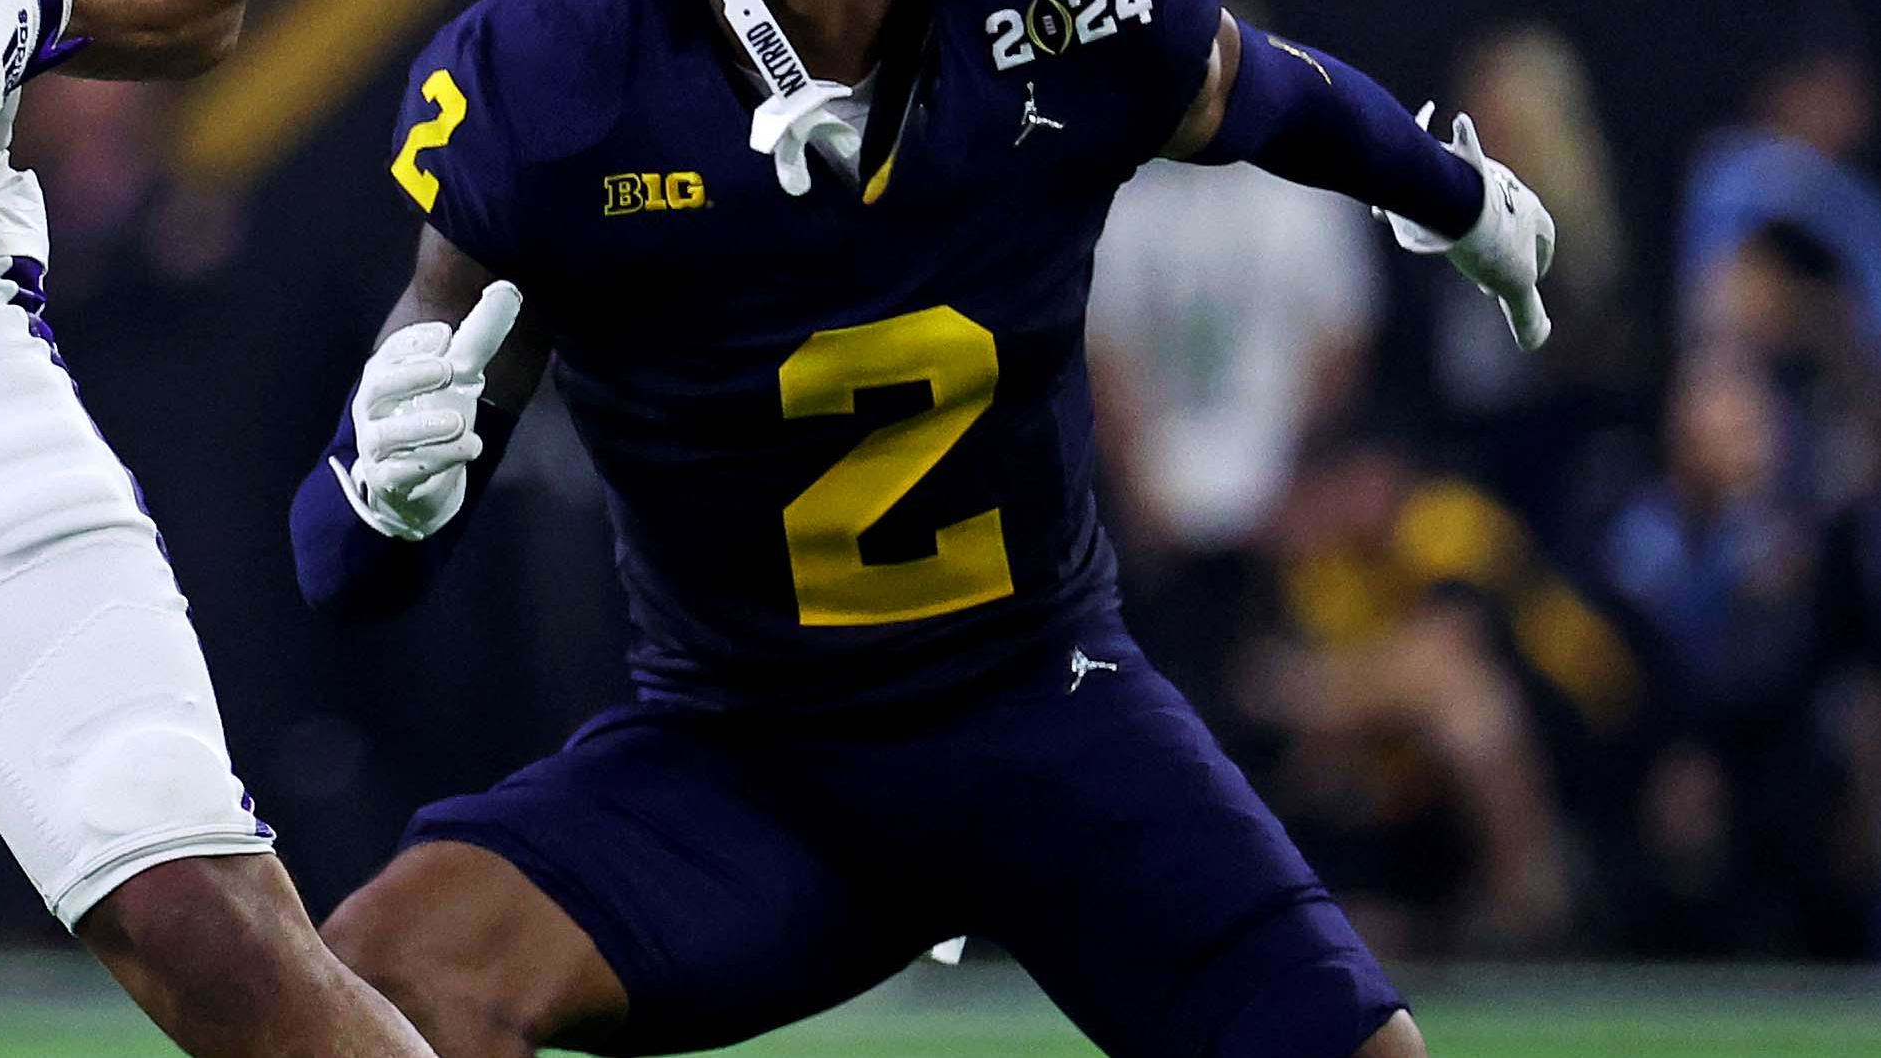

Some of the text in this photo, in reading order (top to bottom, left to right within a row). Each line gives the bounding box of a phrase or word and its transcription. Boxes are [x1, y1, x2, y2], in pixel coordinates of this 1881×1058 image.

[746, 20, 808, 99] NXTRND
[390, 68, 469, 214] 2
[778, 304, 1015, 627] 2
